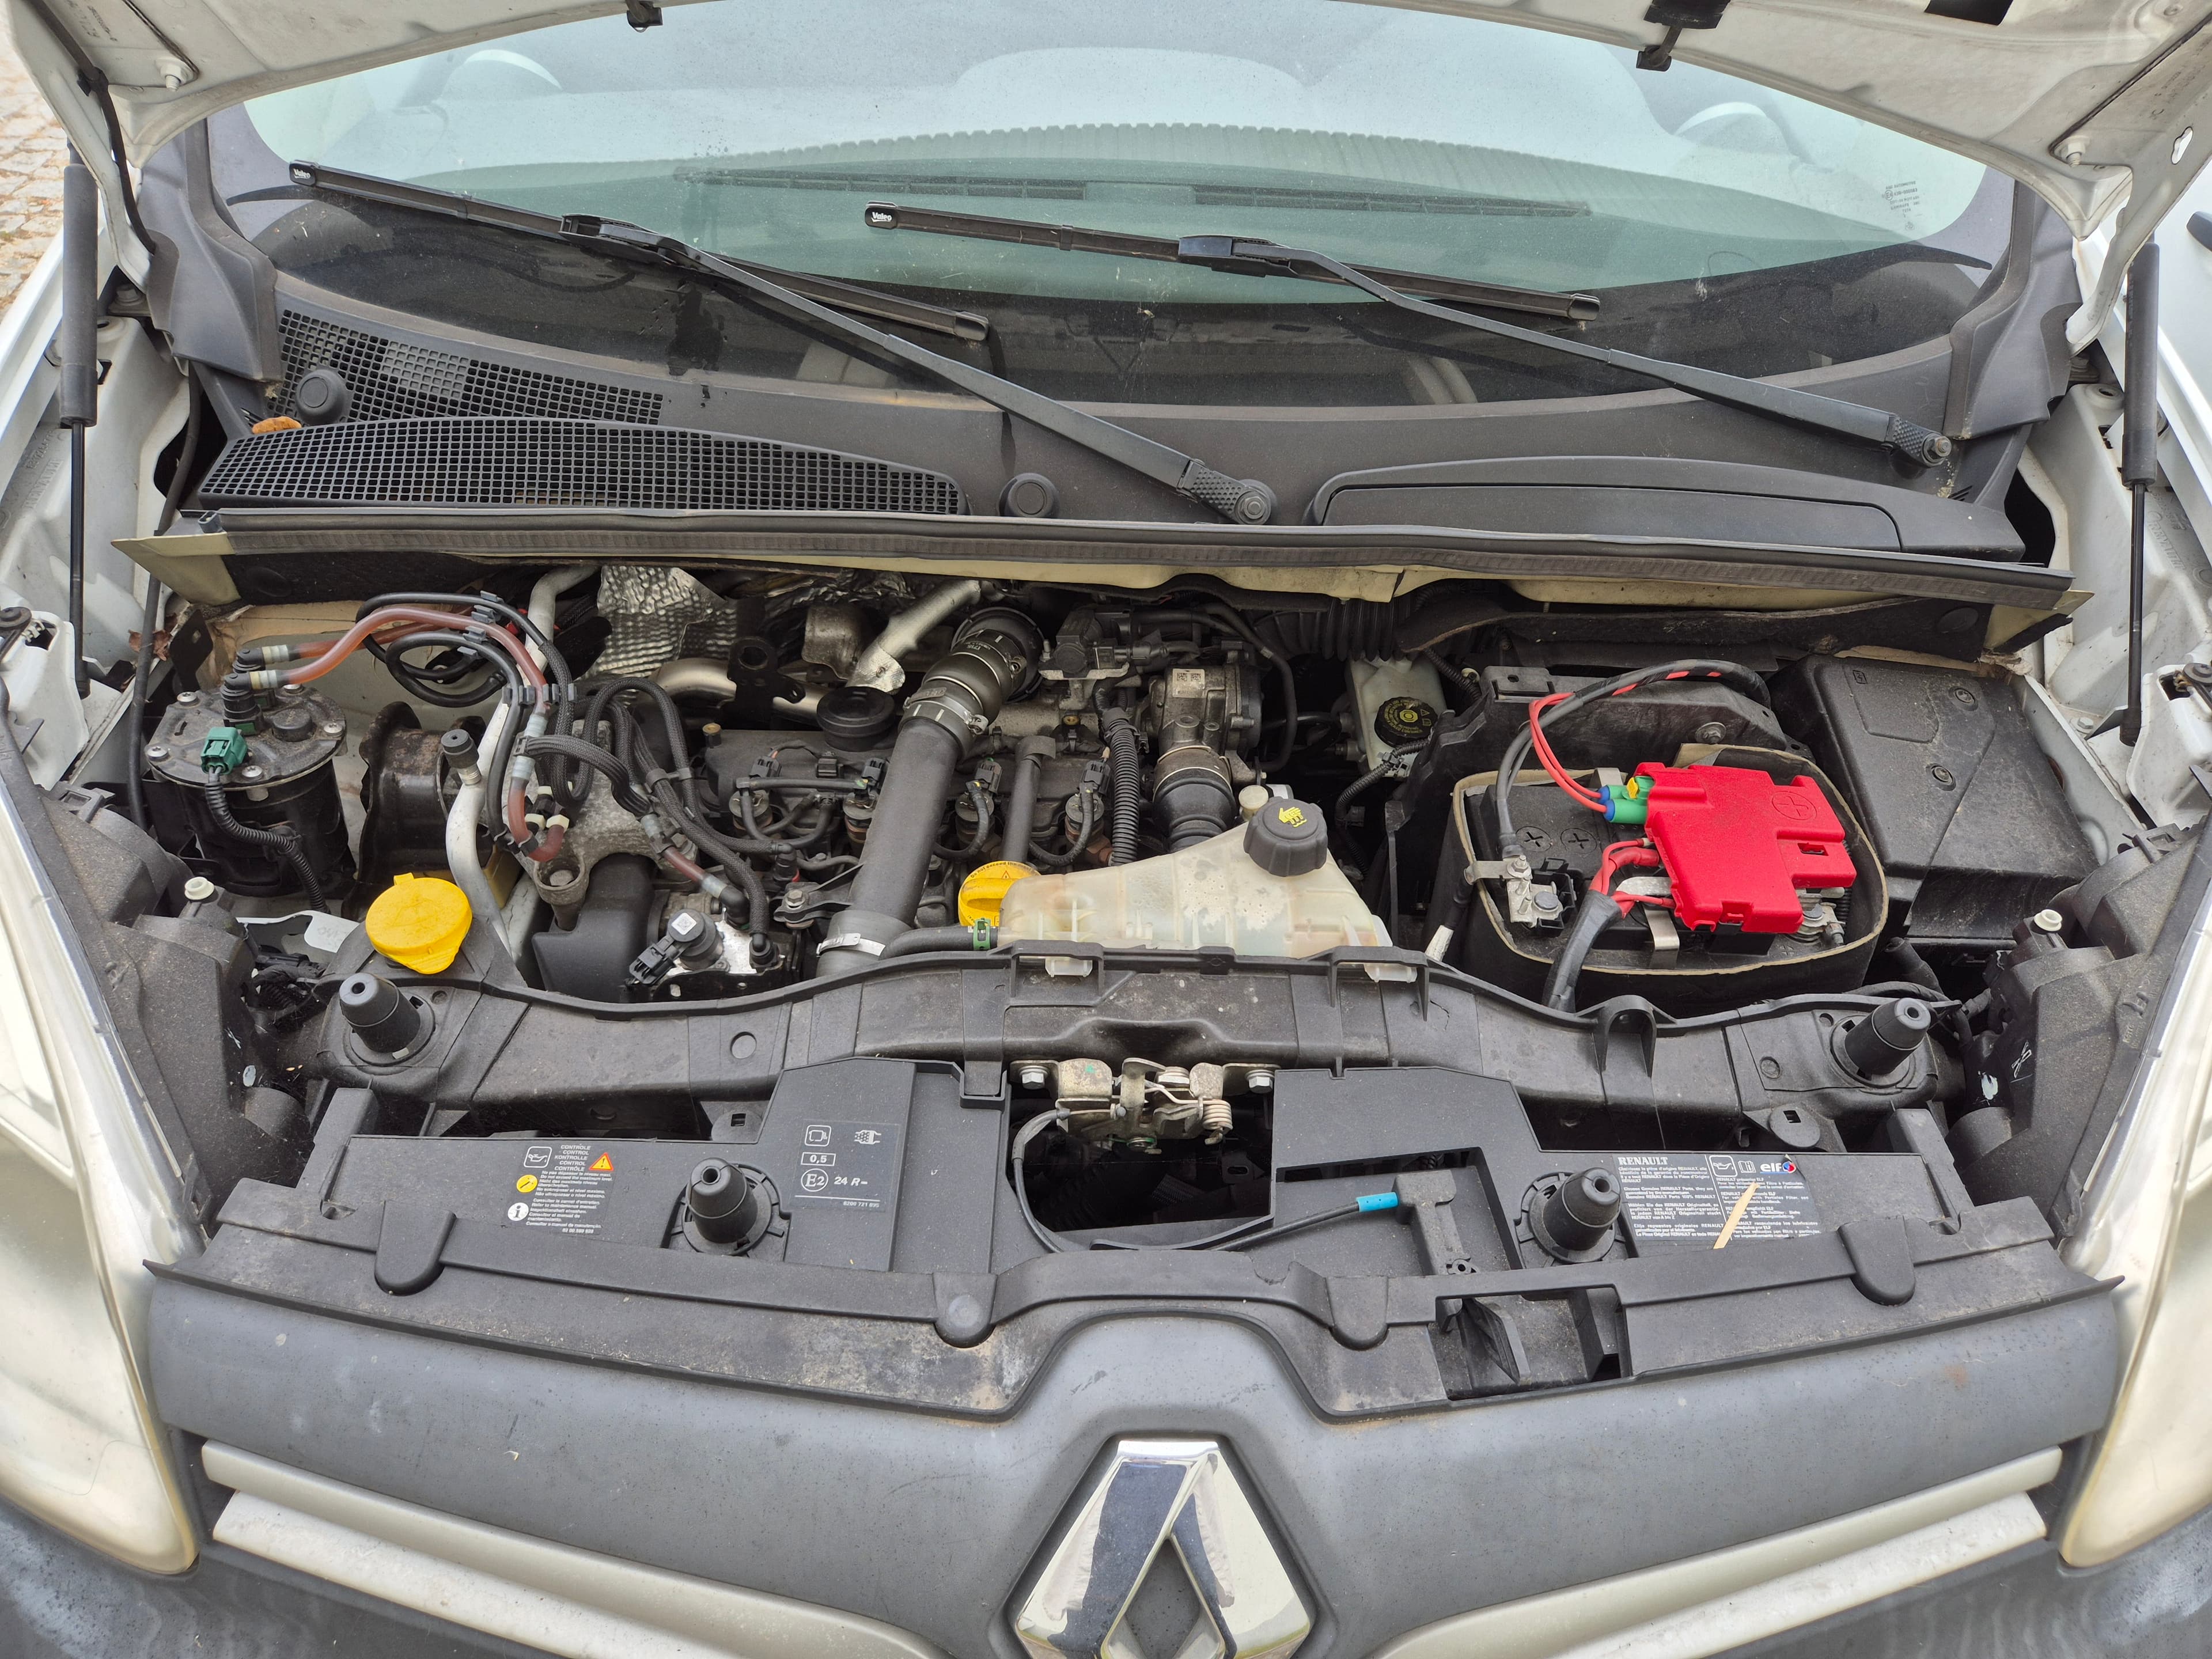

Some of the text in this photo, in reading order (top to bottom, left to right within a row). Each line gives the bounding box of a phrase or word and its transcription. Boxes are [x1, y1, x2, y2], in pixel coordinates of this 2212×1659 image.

[293, 168, 311, 179] Valeo
[872, 211, 893, 221] Valeo
[810, 1154, 827, 1164] 0,5
[1618, 1157, 1668, 1165] RENAULT
[1760, 1162, 1782, 1172] elf
[805, 1173, 825, 1187] E2
[834, 1176, 849, 1185] 24
